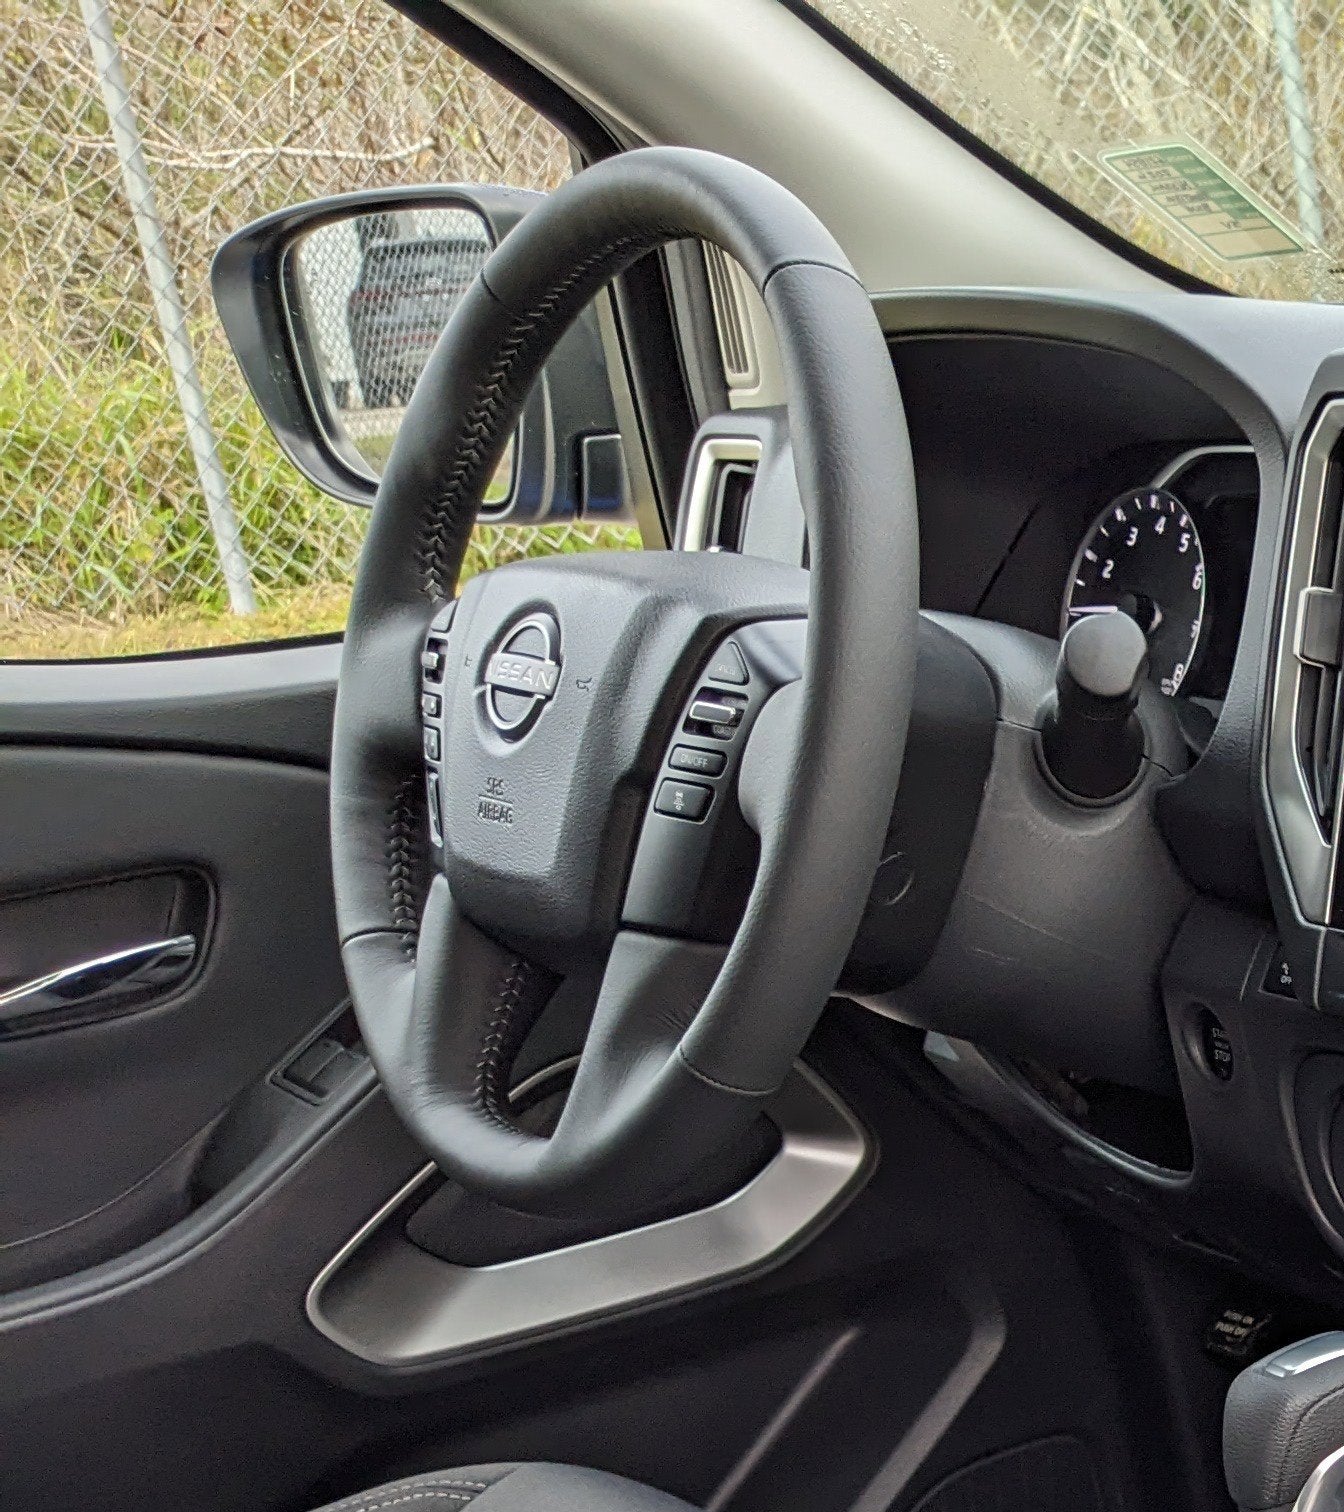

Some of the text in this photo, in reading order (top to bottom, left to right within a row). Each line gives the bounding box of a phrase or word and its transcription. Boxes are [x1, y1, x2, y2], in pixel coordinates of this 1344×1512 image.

[1155, 515, 1167, 534] 4
[1126, 526, 1138, 546] 3
[1179, 533, 1190, 553] 5
[1102, 560, 1114, 579] 2
